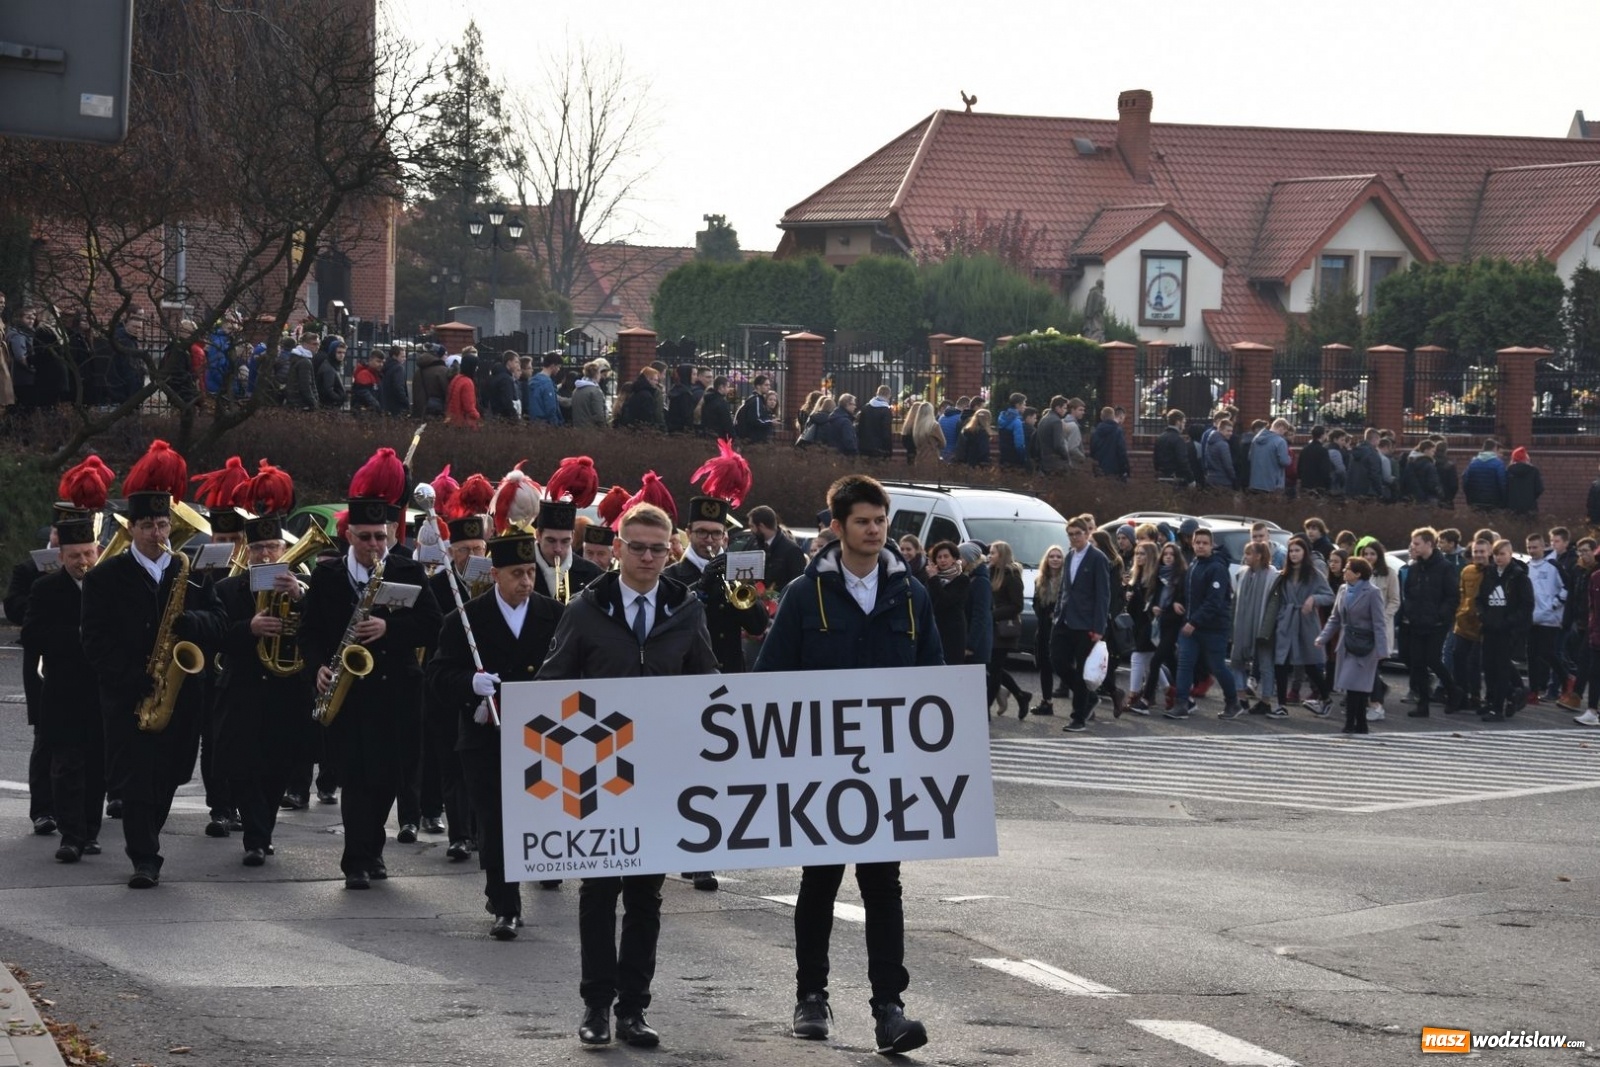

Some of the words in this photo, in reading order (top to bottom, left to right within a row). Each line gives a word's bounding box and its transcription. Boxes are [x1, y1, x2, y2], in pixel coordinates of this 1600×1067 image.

[699, 684, 955, 774] ŚWIĘTO
[676, 774, 970, 853] SZKOŁY
[523, 827, 640, 860] PCKZiU
[525, 860, 598, 872] WODZISŁAW
[603, 857, 642, 870] ŚLĄSKI
